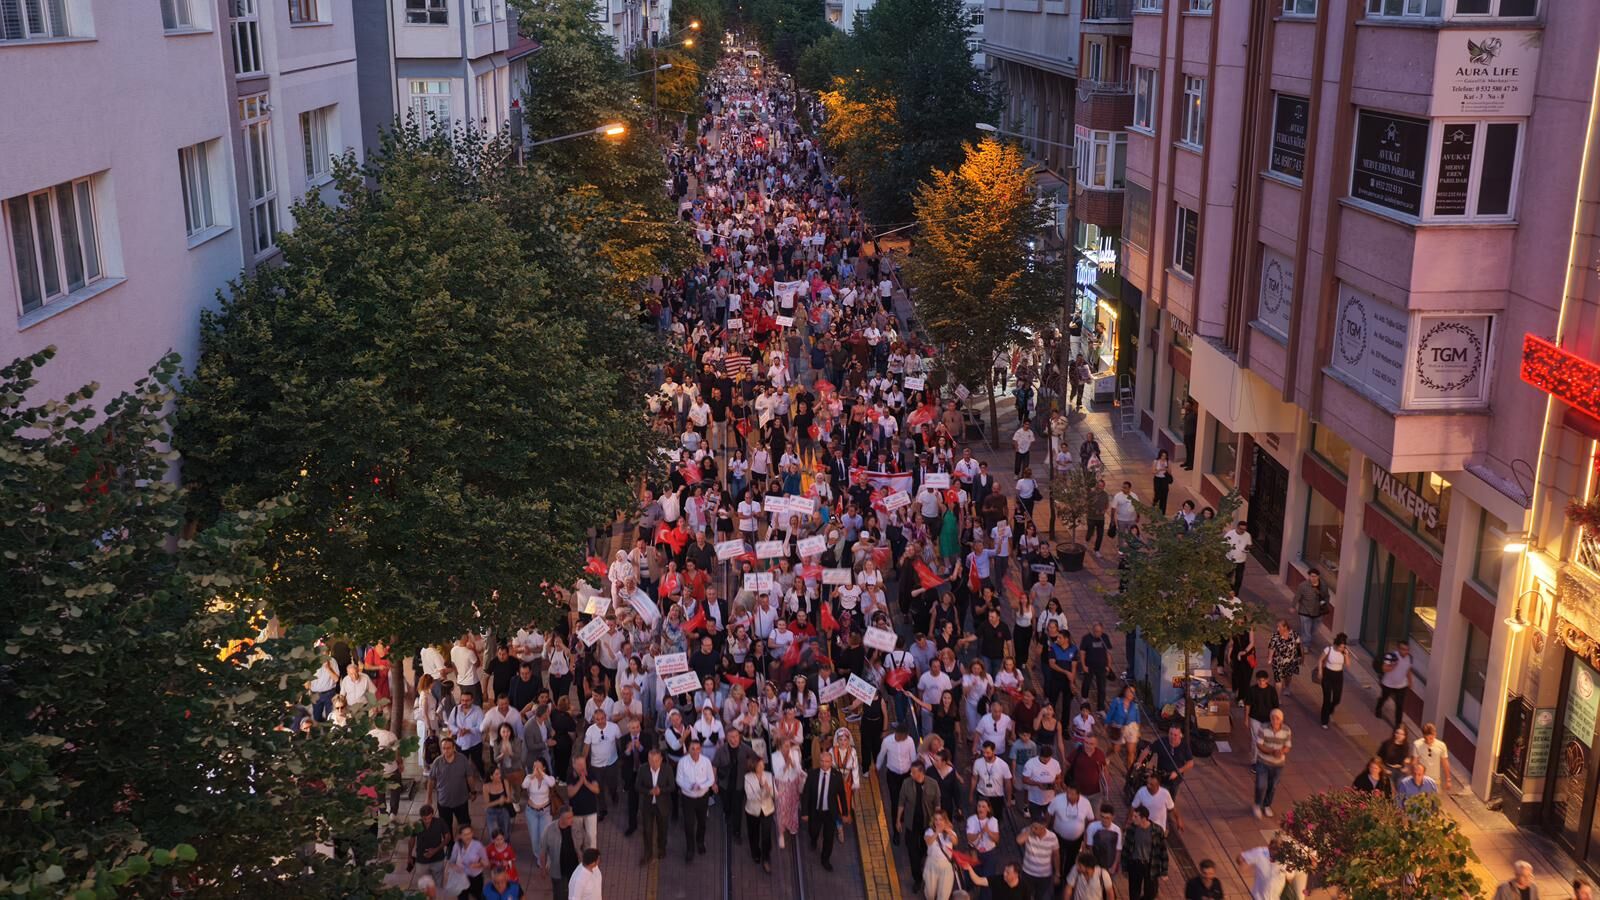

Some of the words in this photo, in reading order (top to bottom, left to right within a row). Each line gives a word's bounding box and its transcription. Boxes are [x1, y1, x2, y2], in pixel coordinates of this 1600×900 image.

[1455, 67, 1488, 76] AURA
[1493, 67, 1519, 76] LIFE
[1378, 150, 1401, 163] AVUKAT
[1346, 319, 1362, 340] TGM
[1430, 347, 1468, 362] TGM
[1371, 462, 1438, 529] WALKER'S
